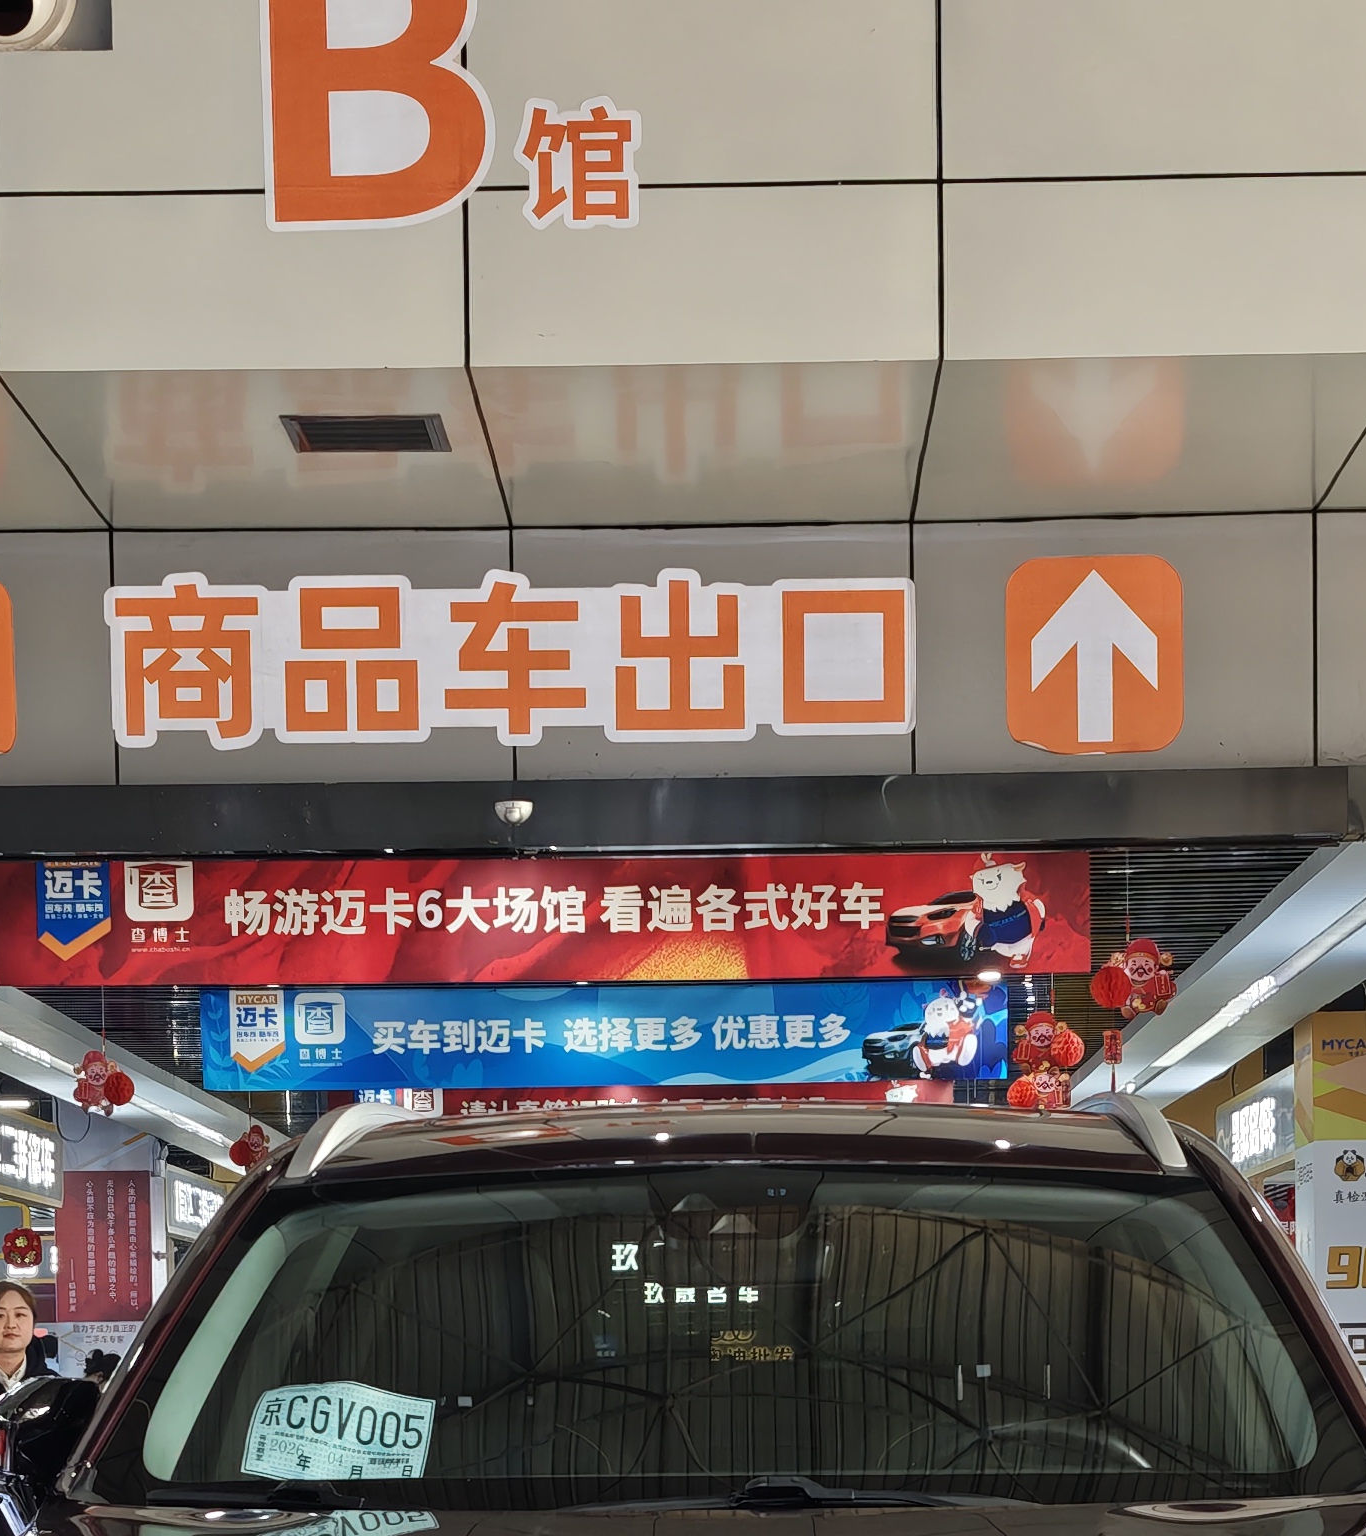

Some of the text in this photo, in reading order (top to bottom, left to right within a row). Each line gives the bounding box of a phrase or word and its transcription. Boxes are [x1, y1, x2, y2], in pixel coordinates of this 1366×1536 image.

[269, 0, 486, 222] B
[522, 105, 632, 220] 馆
[114, 580, 906, 740] 商品车出口
[44, 870, 102, 899] 迈卡
[224, 883, 885, 938] 畅游迈卡6大场馆 看遍各式好车
[131, 927, 190, 943] 查博士
[236, 1007, 277, 1028] 迈卡
[237, 995, 276, 1004] MYCAR
[372, 1011, 852, 1056] 买车到迈卡 选择更多 优惠更多
[611, 1243, 639, 1271] 玖
[260, 1394, 425, 1450] 京CGV005
[270, 1438, 306, 1457] 2026
[296, 1453, 312, 1471] 年
[349, 1465, 363, 1479] 月
[401, 1465, 413, 1478] 日
